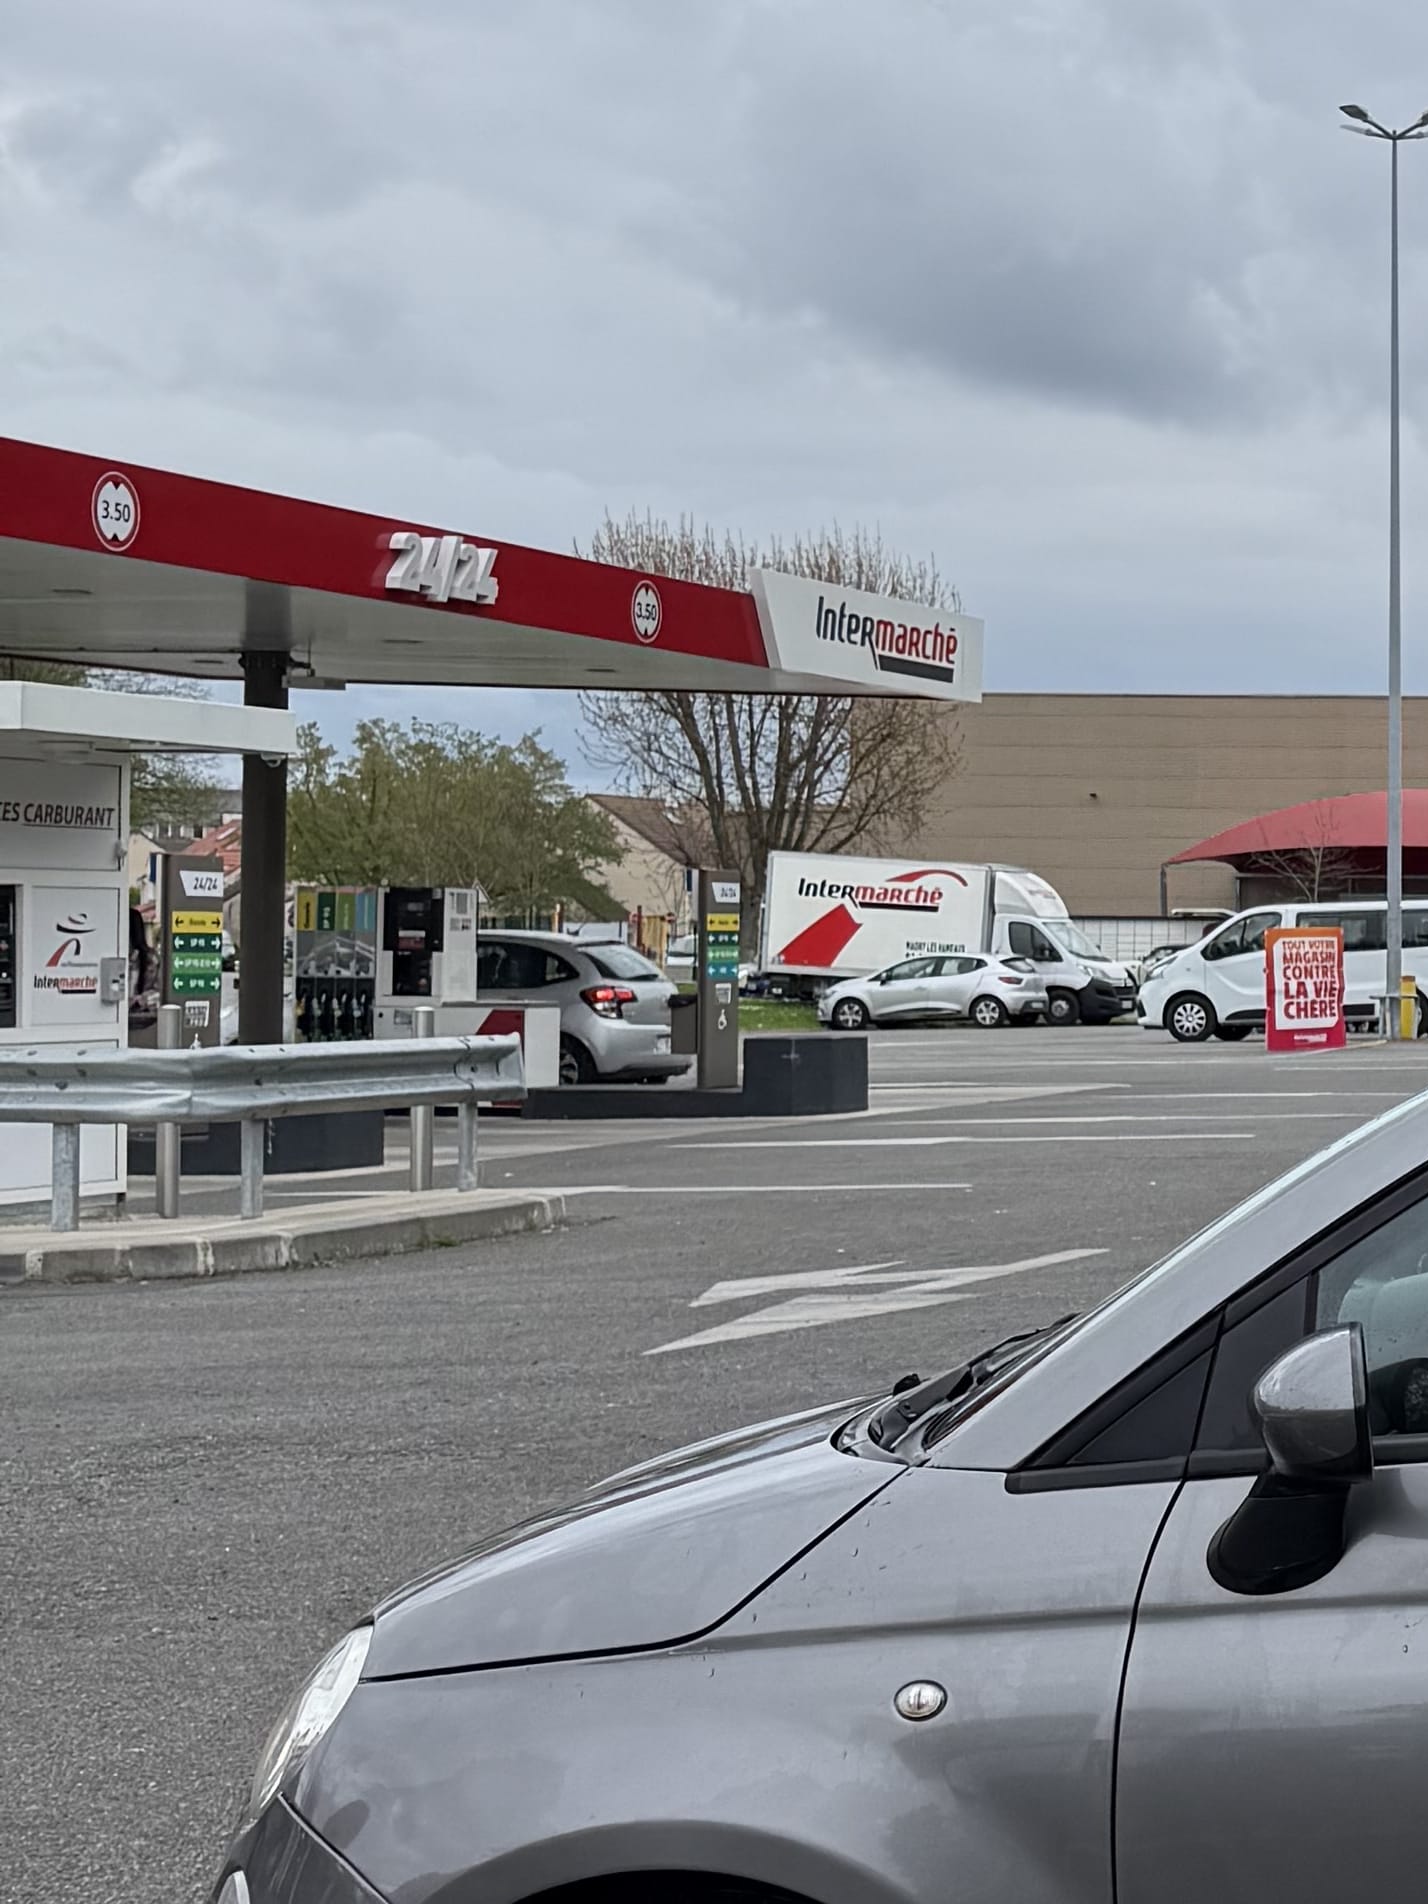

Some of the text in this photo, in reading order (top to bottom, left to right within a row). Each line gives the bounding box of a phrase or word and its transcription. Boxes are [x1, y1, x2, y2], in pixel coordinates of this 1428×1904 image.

[101, 499, 131, 523] 3.50
[385, 532, 499, 605] 24/24
[635, 601, 657, 622] 3.50
[816, 595, 958, 671] Intermarché
[0, 802, 115, 827] ES CARBURANT
[798, 877, 943, 909] Intermarché
[1282, 940, 1305, 952] TOUT
[1282, 951, 1336, 964] MAGASIN
[1283, 965, 1335, 981] CONTRE
[1284, 980, 1337, 999] LA VIE
